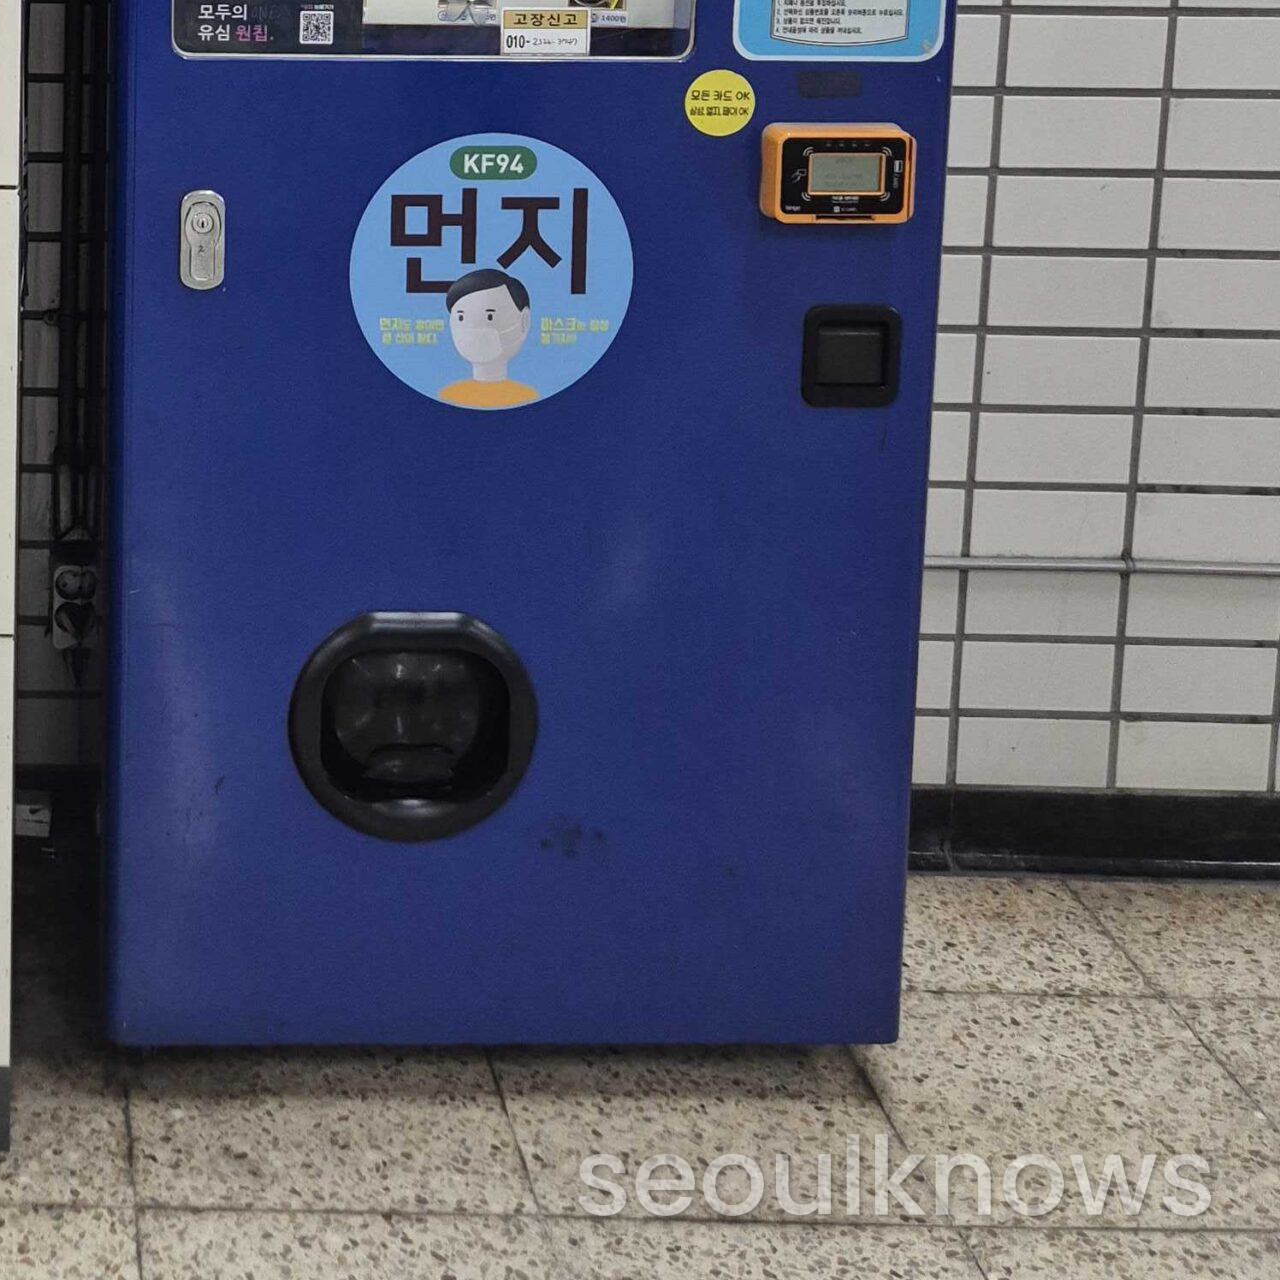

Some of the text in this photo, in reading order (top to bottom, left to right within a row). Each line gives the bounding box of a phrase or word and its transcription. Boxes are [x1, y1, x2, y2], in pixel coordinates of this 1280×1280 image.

[197, 4, 248, 21] 모두의
[513, 13, 578, 27] 고장신고
[197, 24, 231, 42] 유심
[691, 90, 750, 101] 모든 카드 OK
[463, 153, 524, 173] KF94
[390, 187, 589, 295] 먼지
